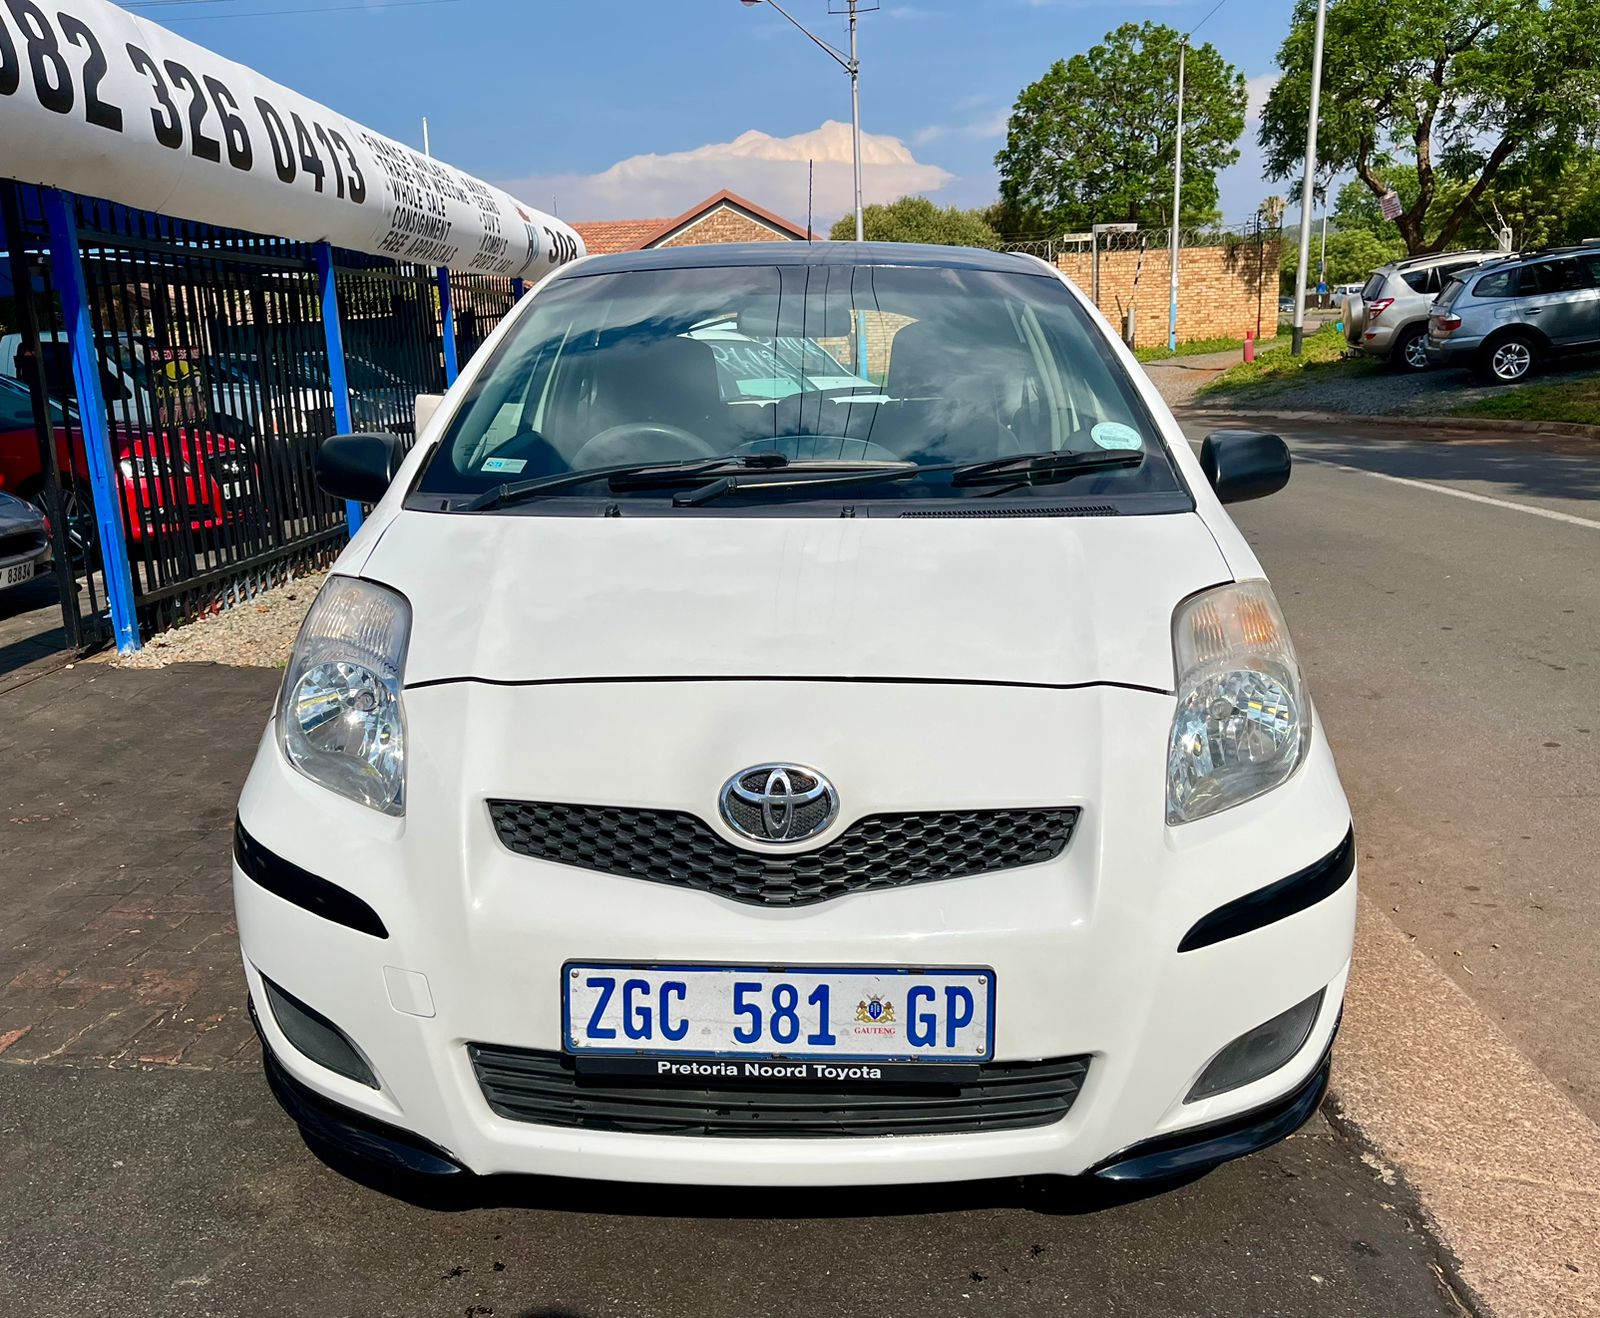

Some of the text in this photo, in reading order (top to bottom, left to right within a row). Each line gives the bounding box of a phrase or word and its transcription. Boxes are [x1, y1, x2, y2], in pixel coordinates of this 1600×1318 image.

[126, 43, 252, 171] 326
[254, 96, 366, 204] 0413
[389, 178, 446, 217] WHOLE SALE
[392, 205, 452, 242] CONSIGNMENT
[377, 230, 459, 263] FREE APPRAISALS
[586, 977, 975, 1048] ZGC 581 GP
[854, 1026, 896, 1035] GAUTENG
[657, 1061, 882, 1080] Pretoria Noord Toyota
